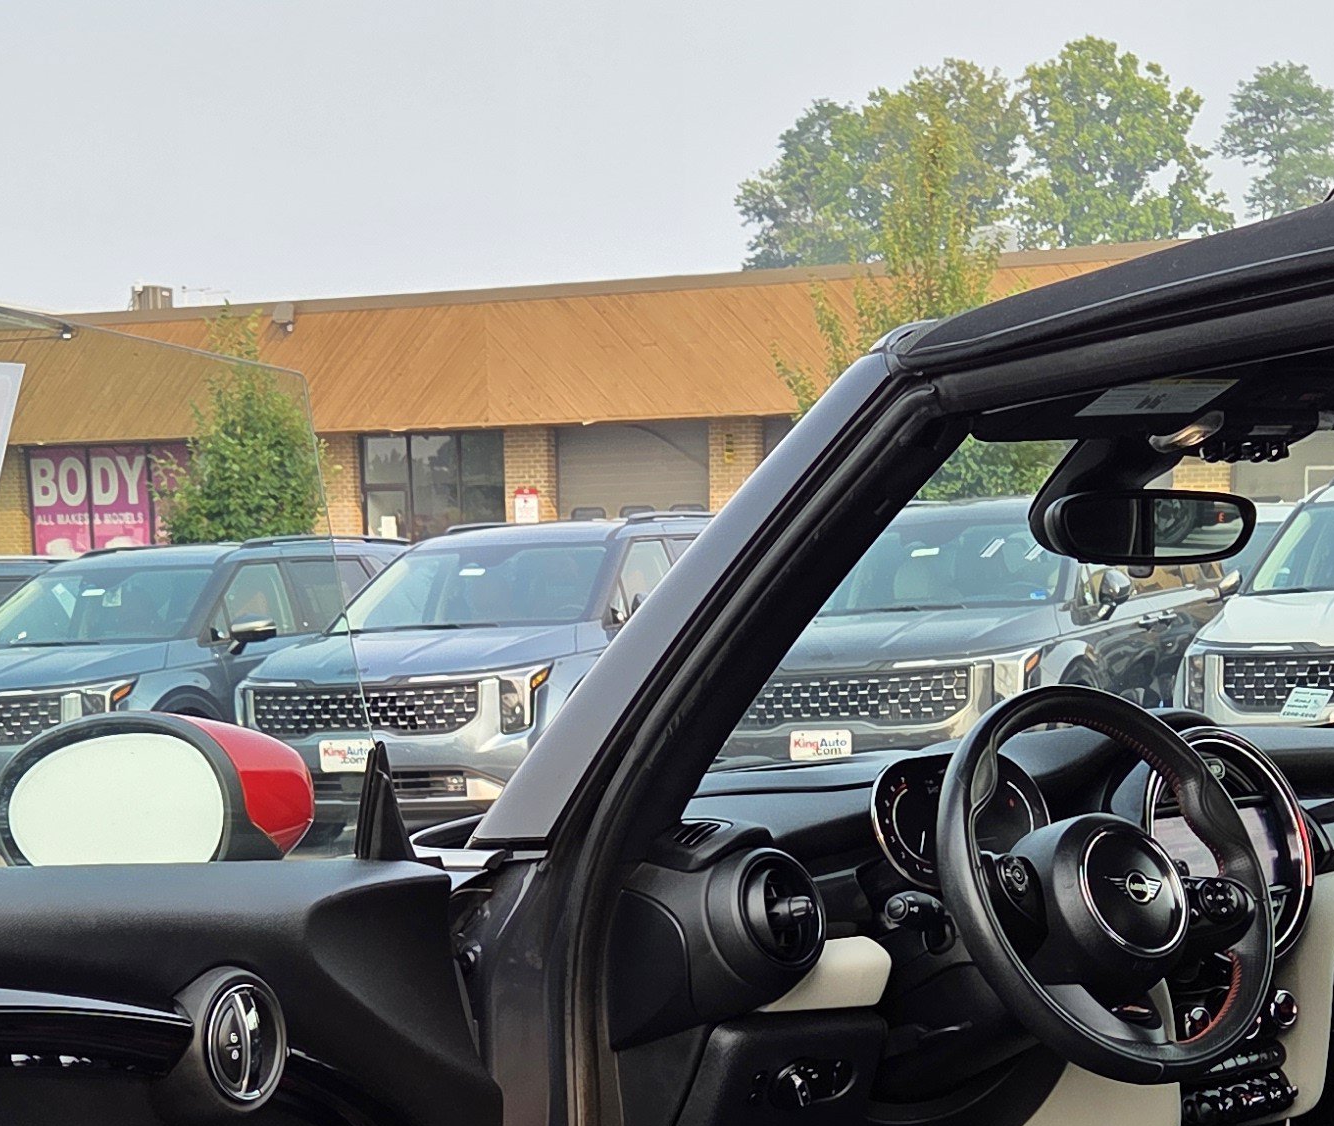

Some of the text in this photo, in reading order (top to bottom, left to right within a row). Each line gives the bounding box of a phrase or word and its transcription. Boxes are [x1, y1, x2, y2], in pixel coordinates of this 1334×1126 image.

[30, 455, 146, 507] BODY
[36, 514, 55, 526] ALL
[56, 512, 90, 526] MAKES
[103, 511, 144, 525] MODELS
[793, 738, 848, 750] KingAuto
